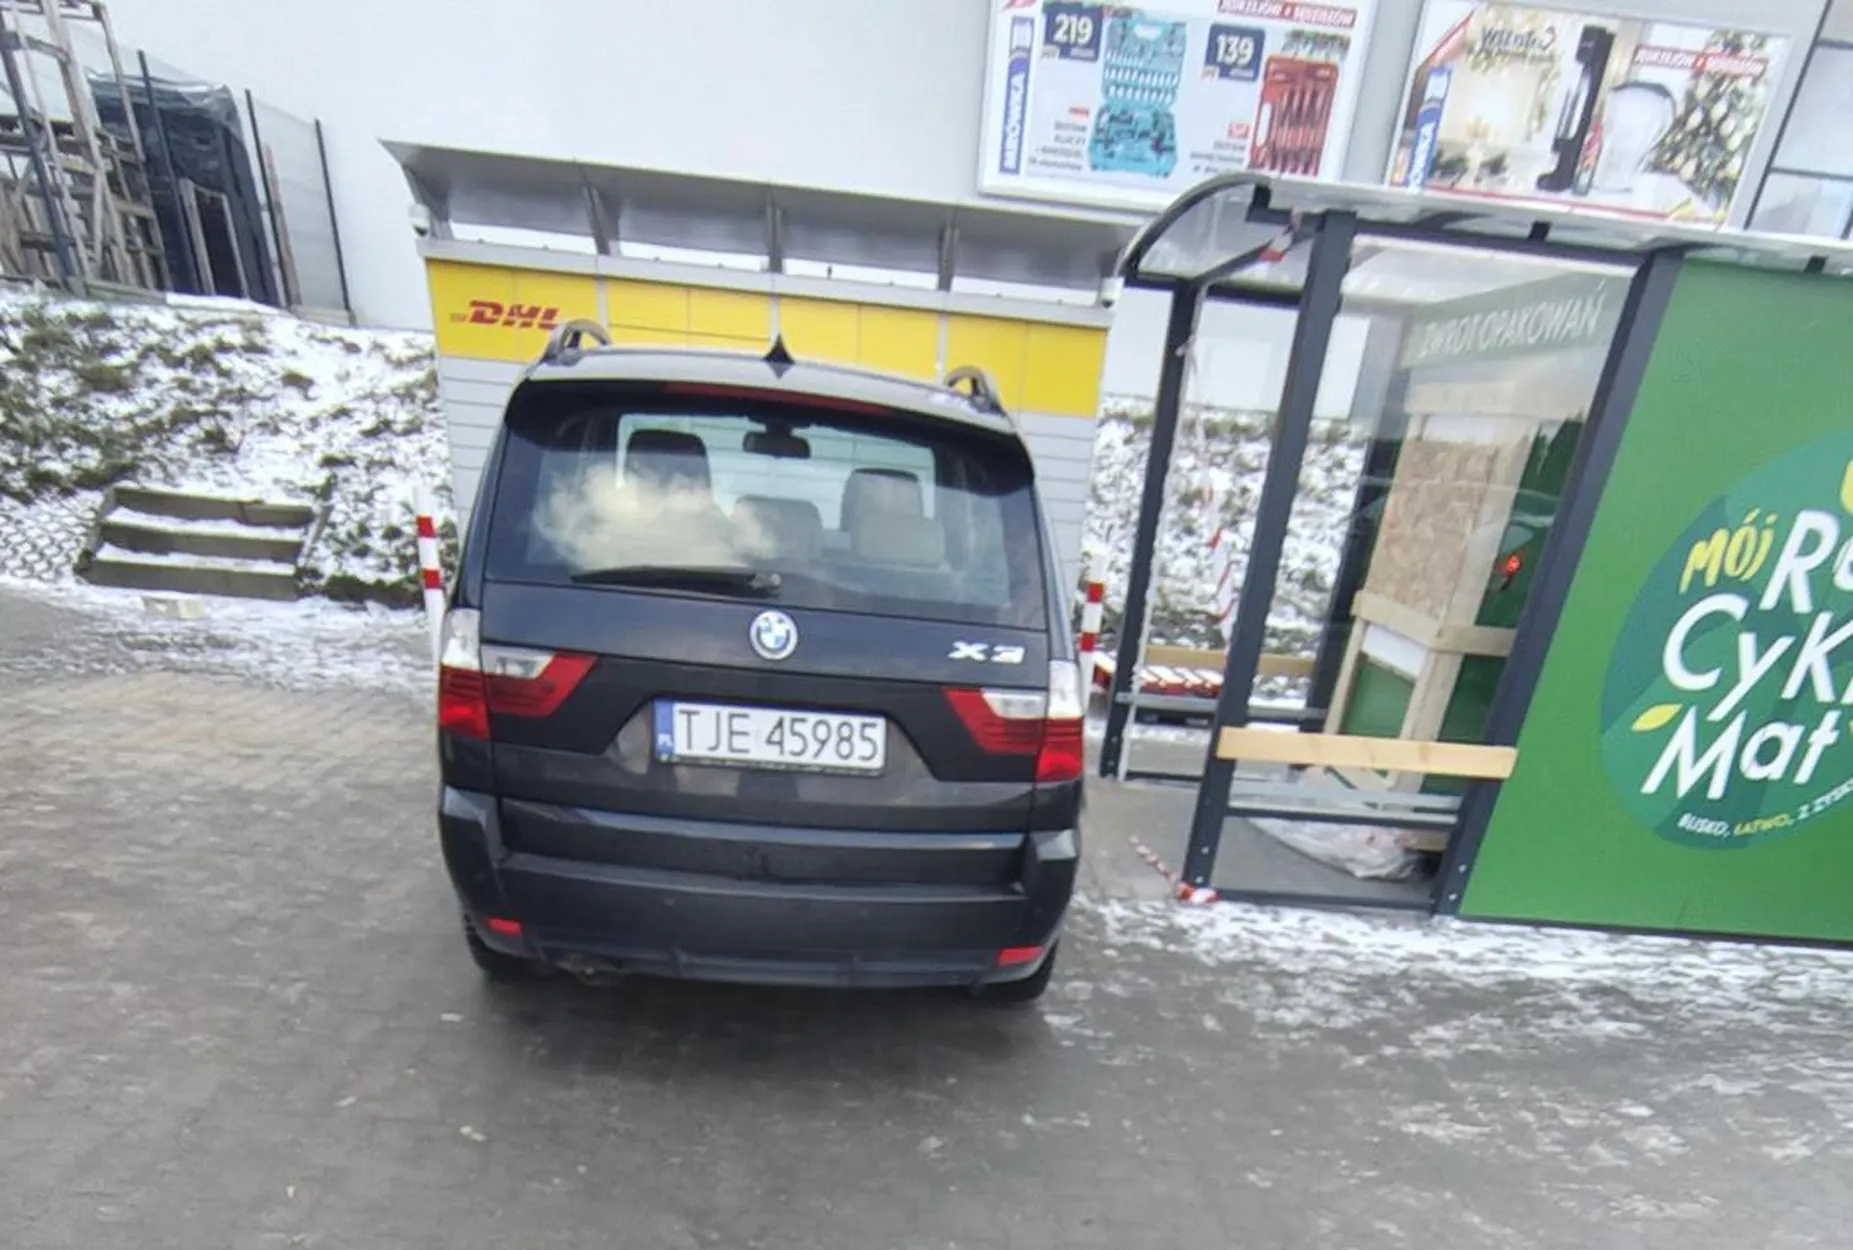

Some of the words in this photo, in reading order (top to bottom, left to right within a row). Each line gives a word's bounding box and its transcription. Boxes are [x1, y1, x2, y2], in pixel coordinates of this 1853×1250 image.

[1053, 13, 1093, 45] 219
[1216, 33, 1255, 65] 139
[469, 300, 559, 330] DHL
[947, 641, 1025, 664] X3
[678, 708, 751, 753] TJE
[765, 715, 878, 762] 45985
